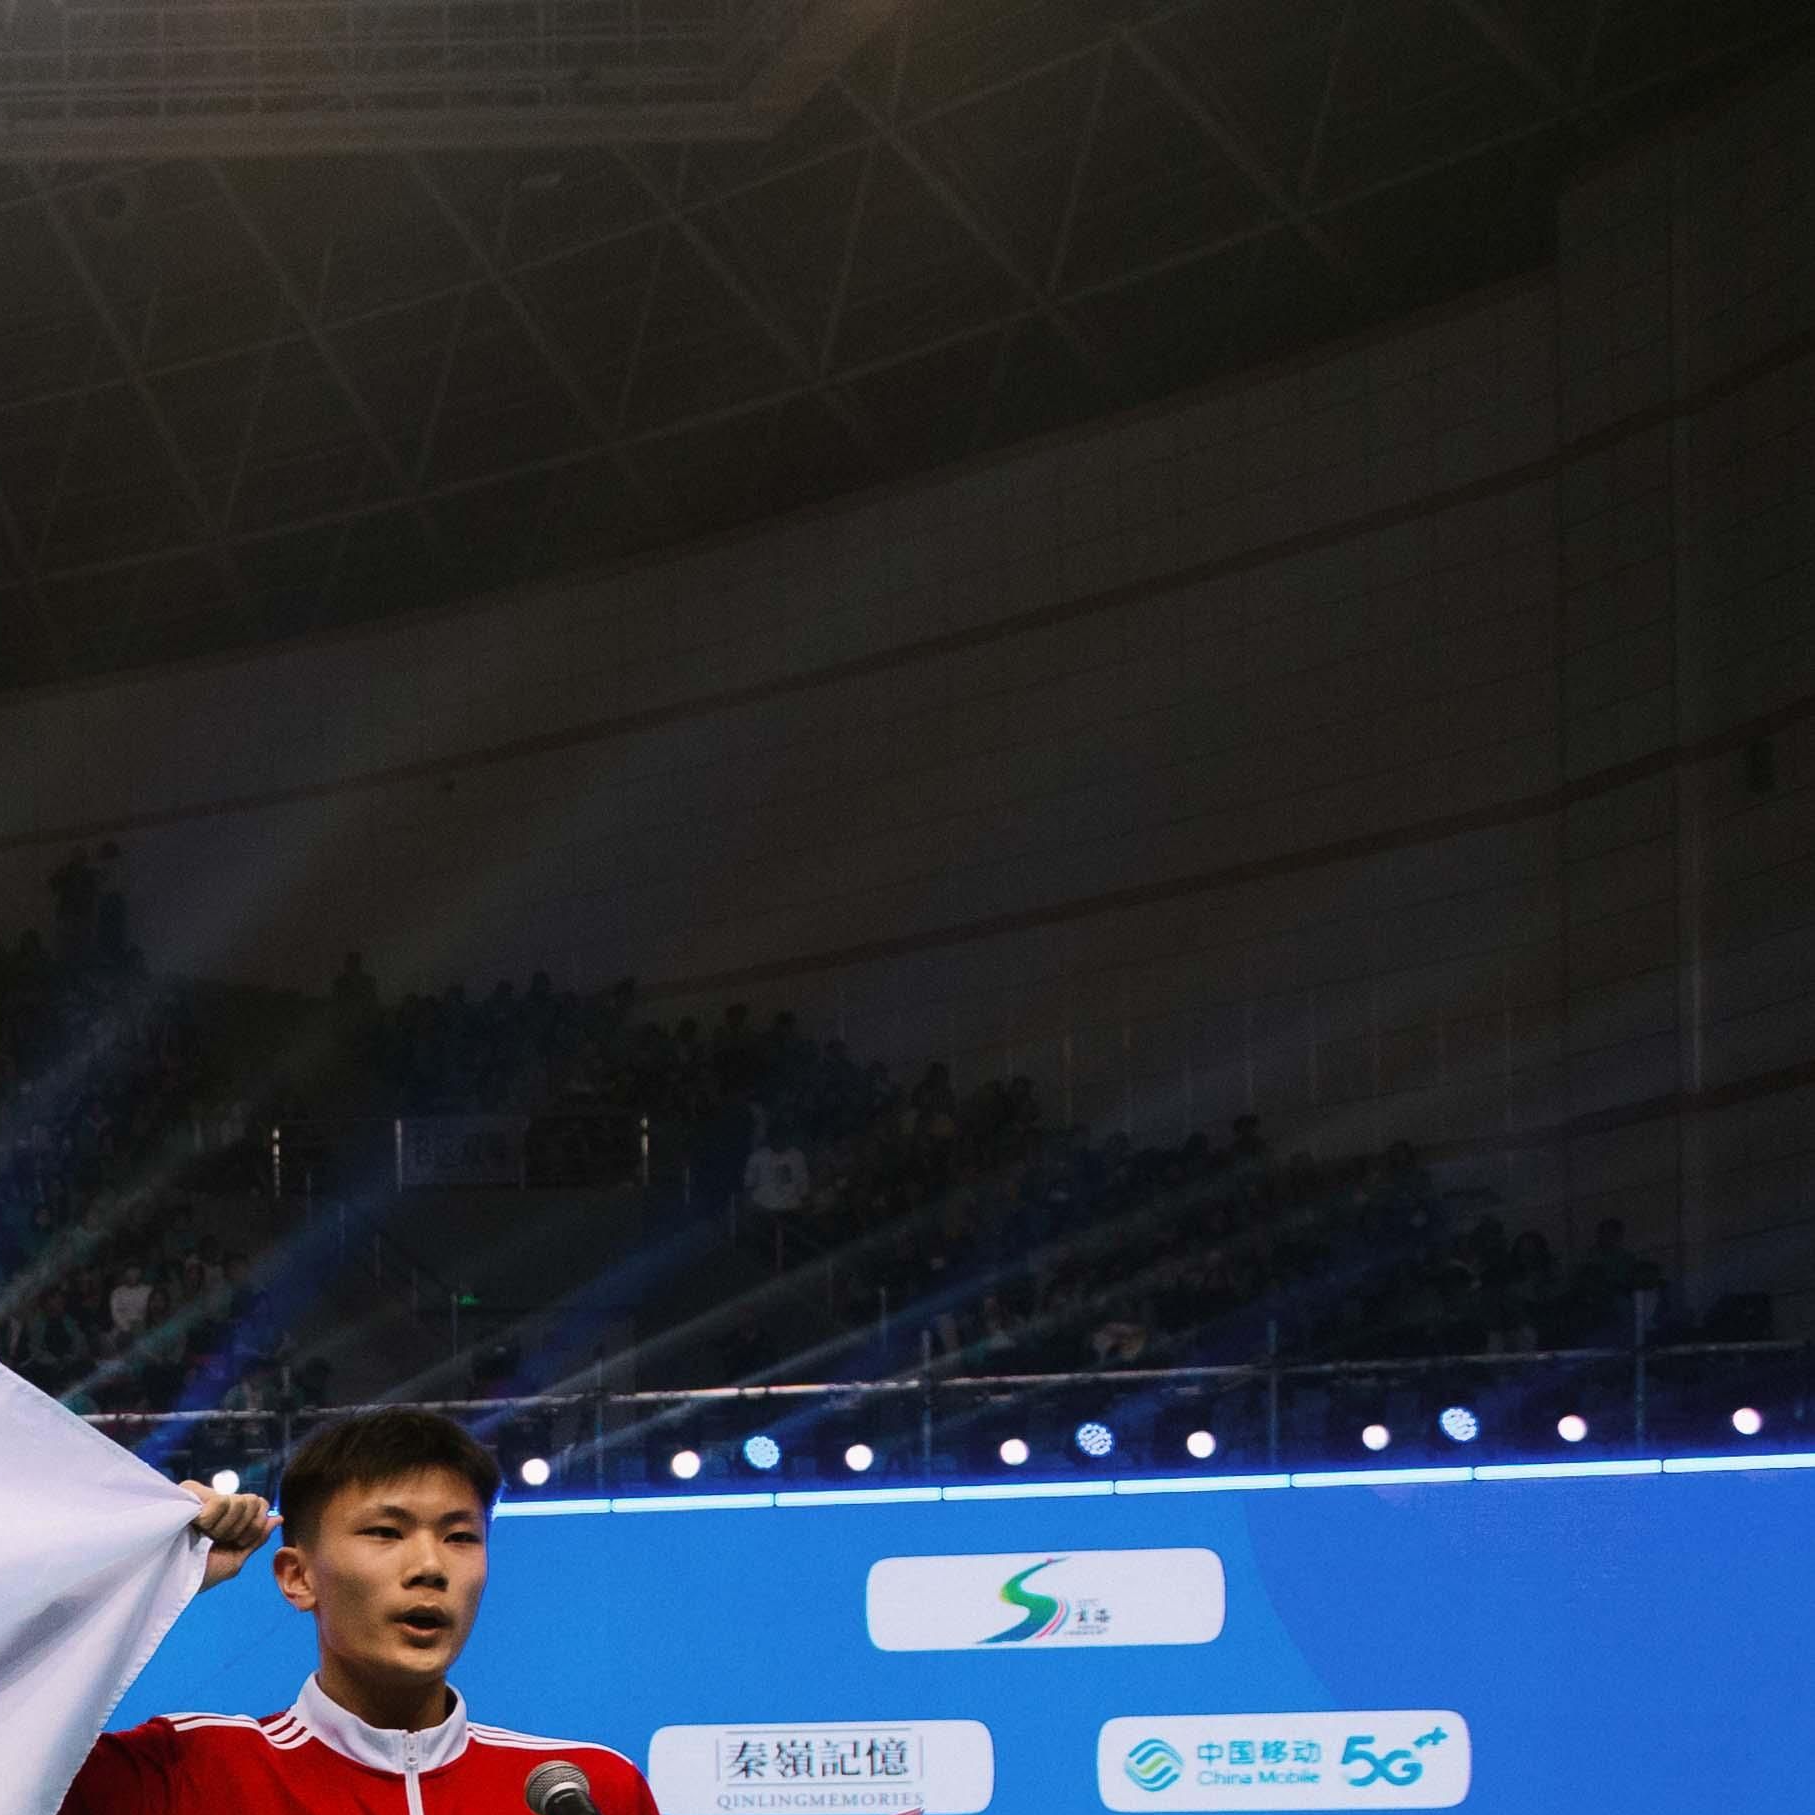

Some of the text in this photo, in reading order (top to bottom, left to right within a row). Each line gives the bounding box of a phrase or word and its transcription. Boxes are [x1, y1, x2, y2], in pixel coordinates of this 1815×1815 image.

[727, 1737, 910, 1779] 秦嶺記憶
[1196, 1740, 1322, 1765] 中国移动
[1197, 1770, 1321, 1786] China Mobile
[716, 1791, 926, 1811] QINLINGMEMORIES
